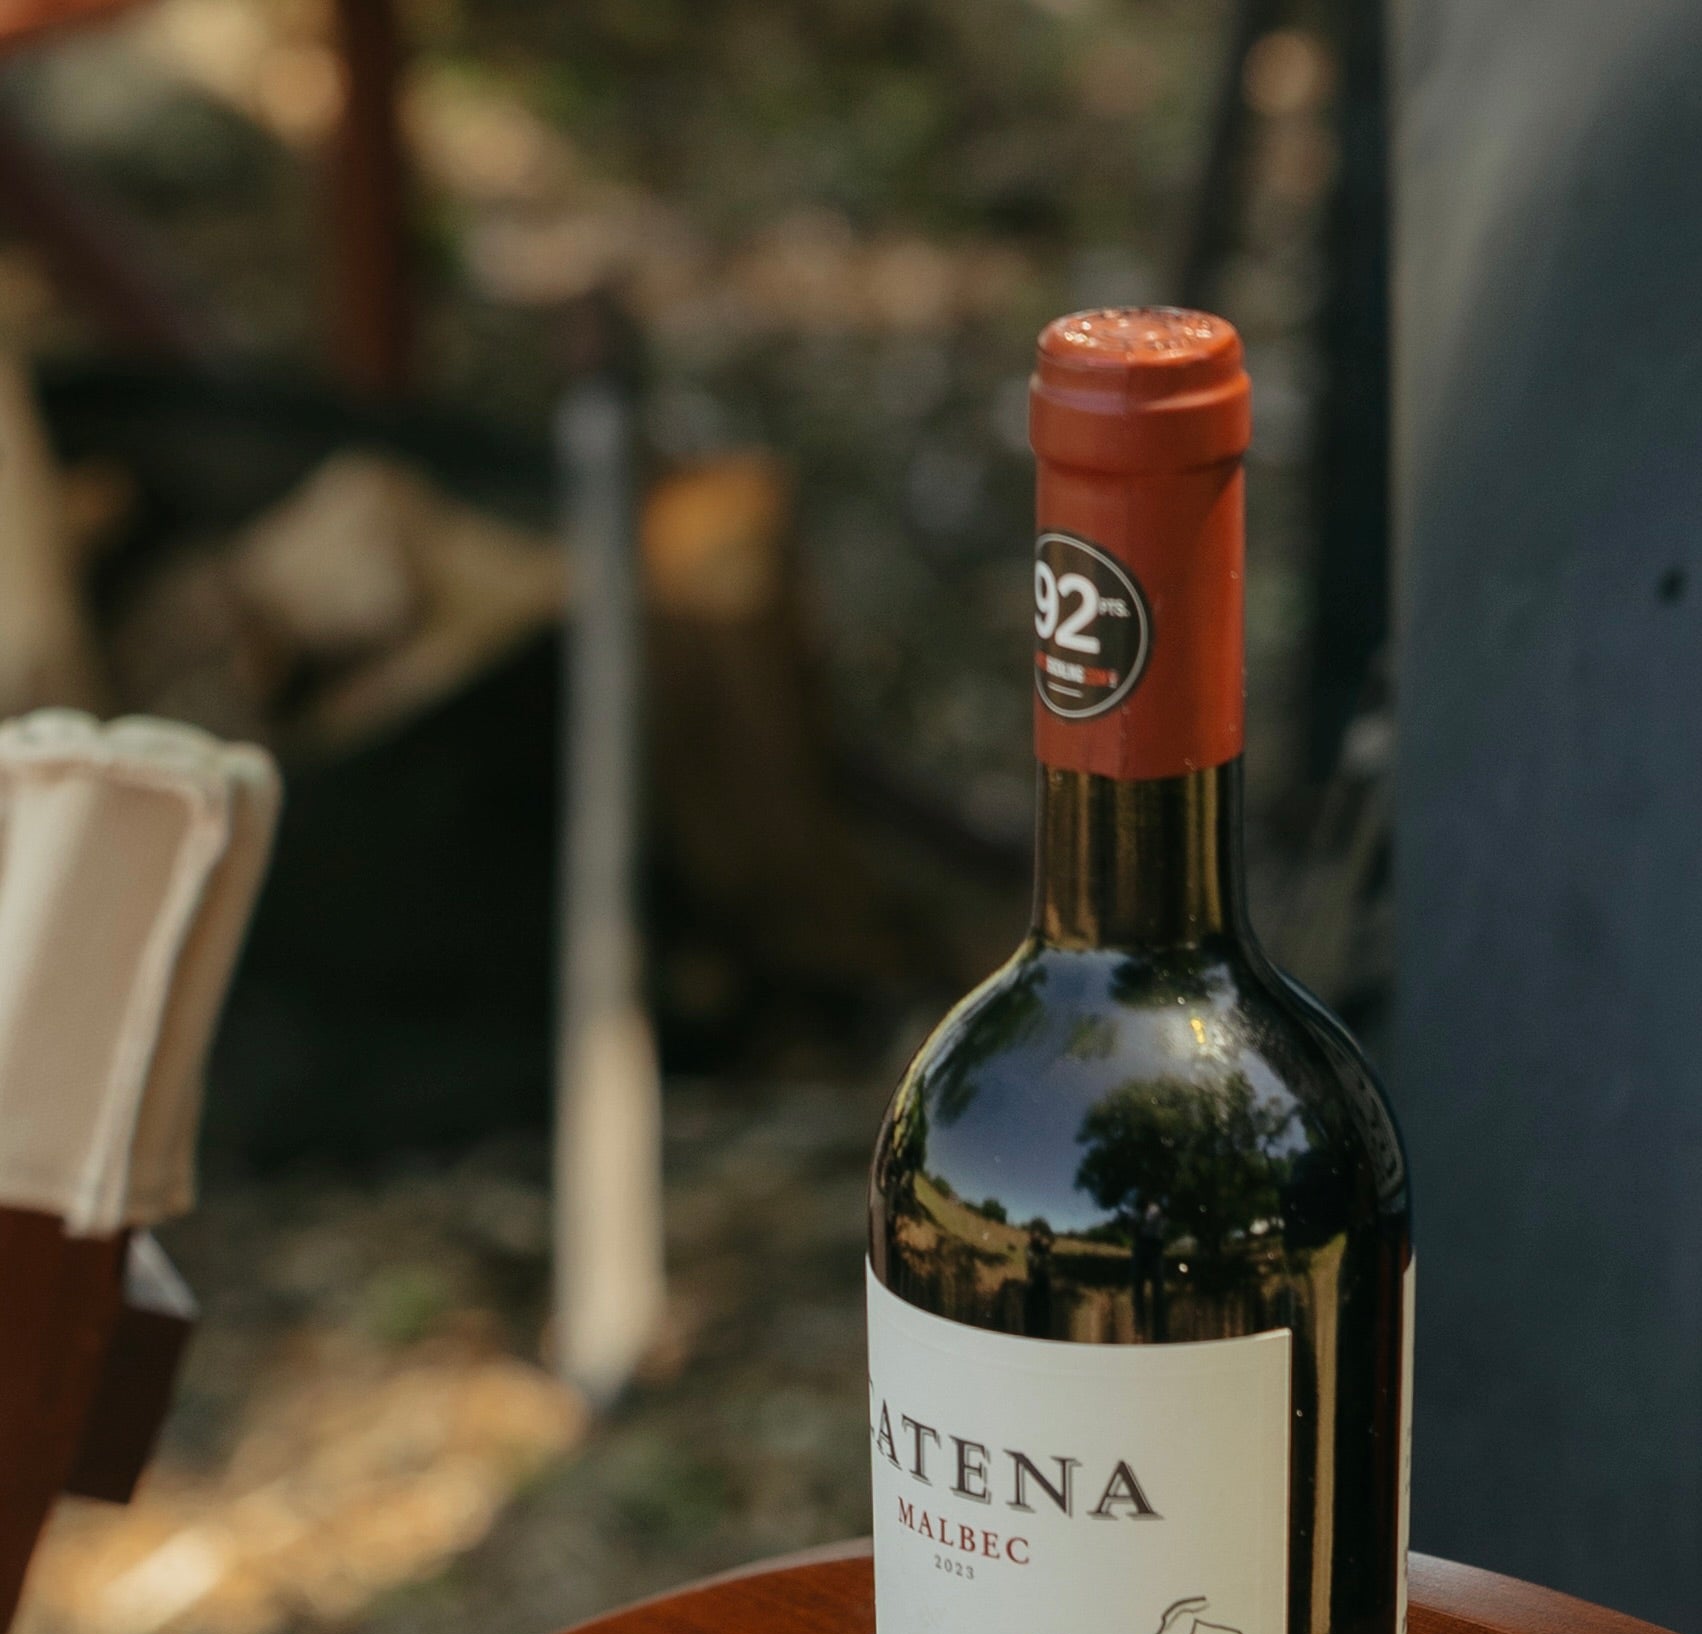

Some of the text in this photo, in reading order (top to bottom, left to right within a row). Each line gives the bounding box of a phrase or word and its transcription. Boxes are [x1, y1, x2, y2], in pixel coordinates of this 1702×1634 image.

[1034, 560, 1100, 655] 92
[869, 1379, 1164, 1521] ATENA
[897, 1496, 1031, 1566] MALBEC
[934, 1554, 975, 1581] 2023
